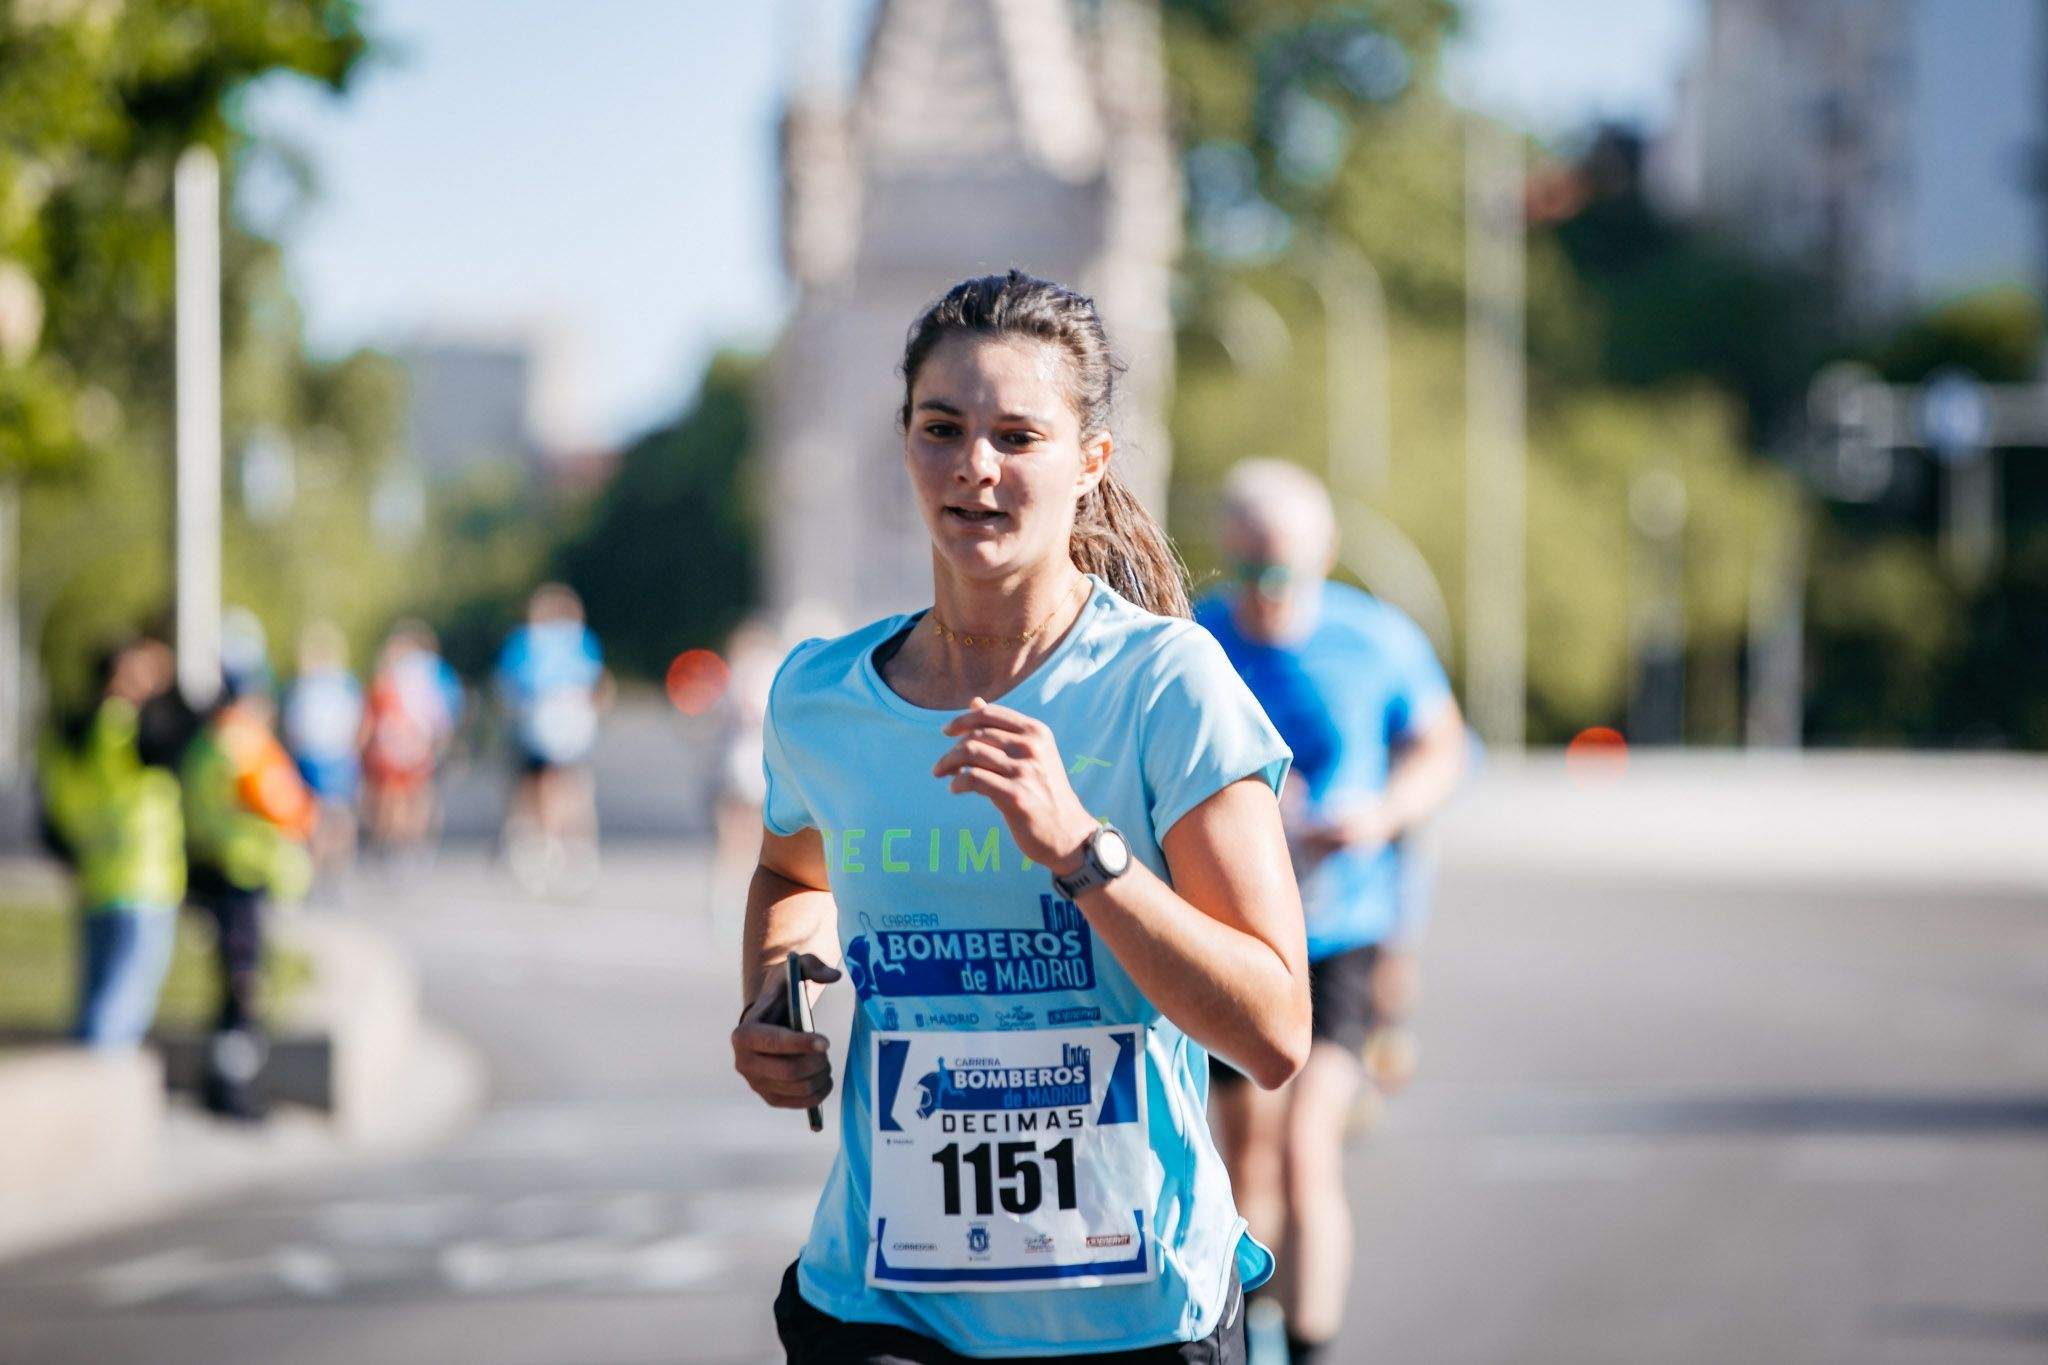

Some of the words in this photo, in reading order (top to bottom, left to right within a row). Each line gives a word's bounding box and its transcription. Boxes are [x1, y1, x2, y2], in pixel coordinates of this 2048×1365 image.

[882, 912, 939, 927] CARRERA
[888, 931, 1082, 961] BOMBEROS
[961, 963, 988, 992] de
[996, 958, 1088, 991] MADRID
[929, 1013, 980, 1025] MADRID
[955, 1058, 1001, 1067] CARRERA
[954, 1067, 1086, 1089] BOMBEROS
[1004, 1092, 1023, 1108] de
[1028, 1086, 1087, 1106] MADRID
[942, 1109, 1084, 1133] DECIMAS
[932, 1138, 1077, 1215] 1151
